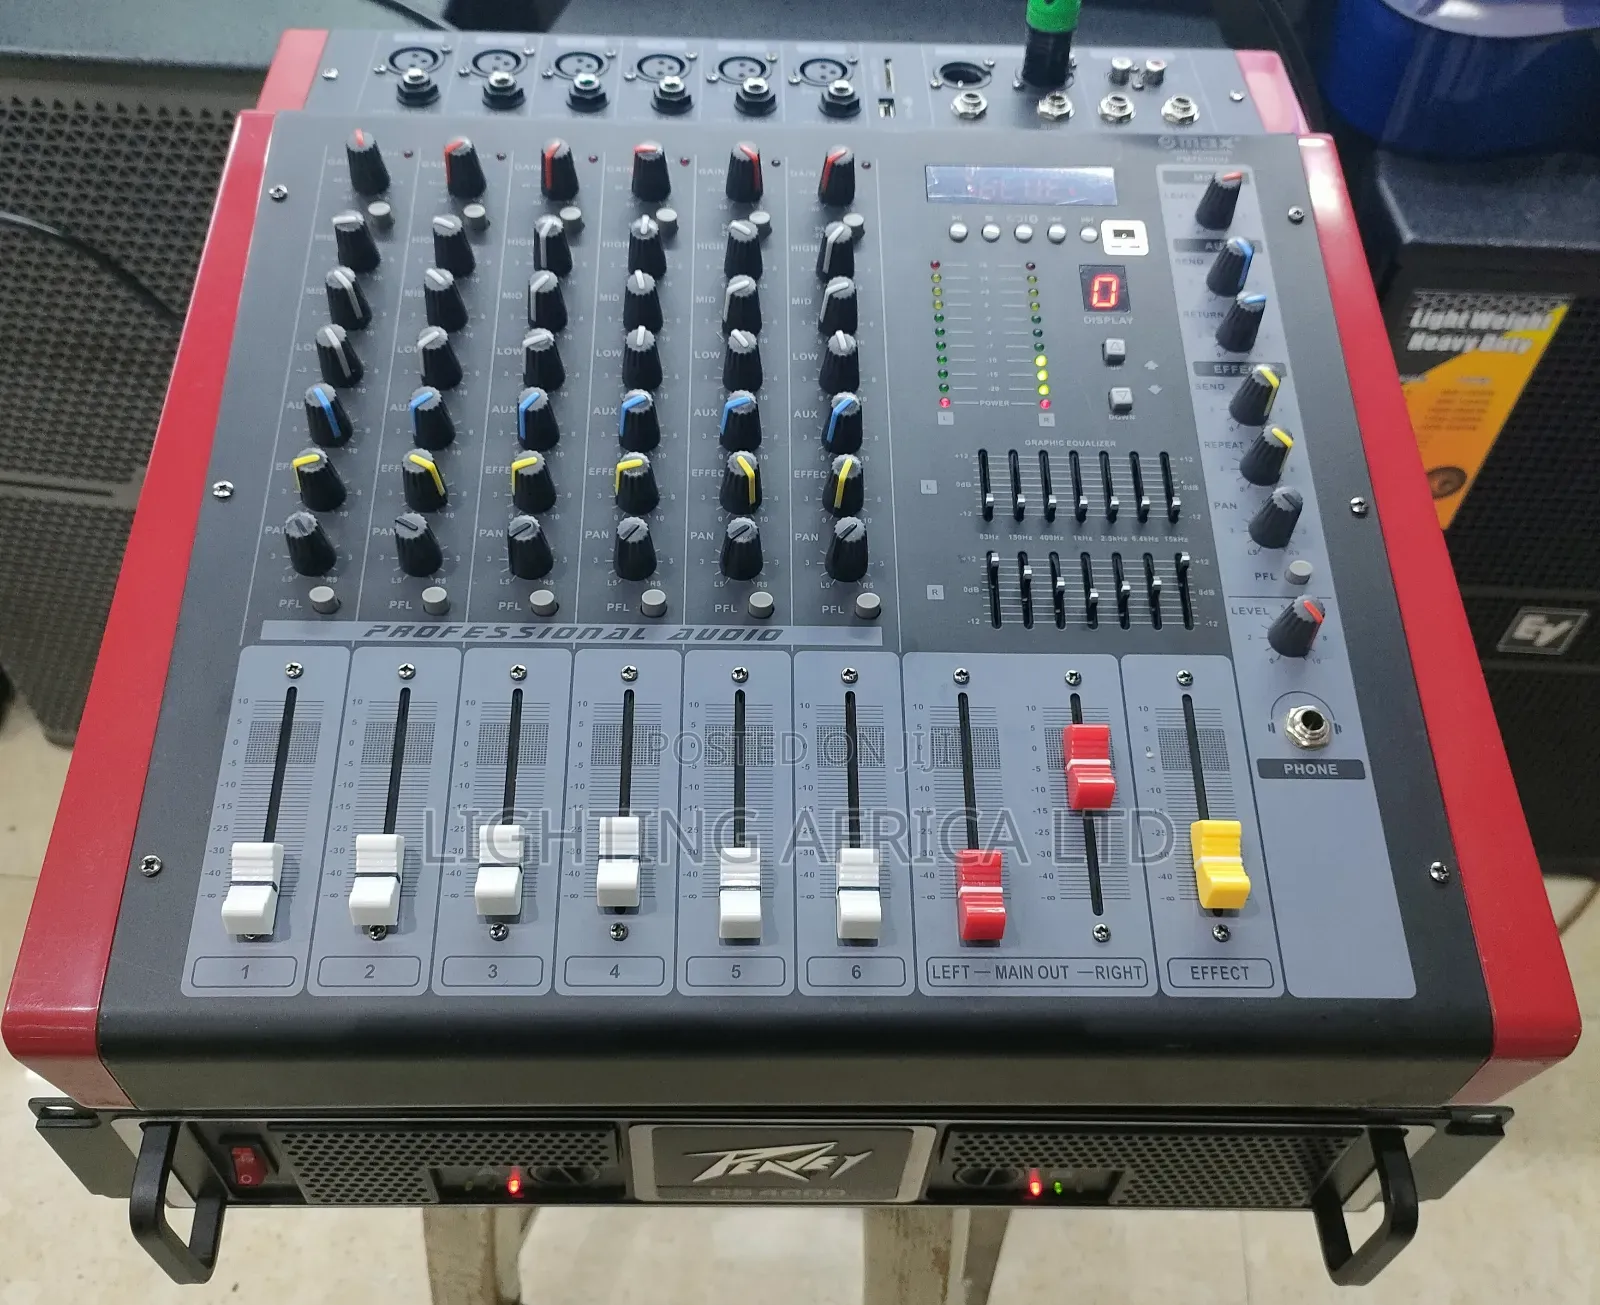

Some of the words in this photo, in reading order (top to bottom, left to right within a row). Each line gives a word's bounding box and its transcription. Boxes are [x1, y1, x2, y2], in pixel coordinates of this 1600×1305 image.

[699, 168, 725, 176] GAIN
[1092, 274, 1120, 308] 0
[502, 292, 522, 300] MID
[600, 293, 620, 301] MID
[696, 296, 716, 304] MID
[792, 296, 812, 305] MID
[1183, 310, 1224, 318] RETURN
[1084, 316, 1133, 325] DISPLAY
[497, 348, 524, 356] LOW
[596, 350, 622, 358] LOW
[694, 351, 720, 359] LOW
[792, 352, 818, 360] LOW
[286, 401, 304, 410] AU
[492, 405, 517, 414] AUX
[592, 407, 618, 416] AUX
[694, 408, 718, 417] AUX
[794, 410, 818, 418] AUX
[1204, 441, 1244, 449] REPEAT
[486, 466, 510, 474] EFFE
[588, 468, 614, 476] EFFE
[692, 470, 724, 478] EFFEC
[794, 470, 829, 479] EFFEC
[1214, 502, 1237, 510] PAN
[479, 530, 504, 538] PAN
[585, 530, 609, 539] PAN
[690, 532, 714, 540] PAN
[795, 532, 819, 541] PAN
[1255, 572, 1277, 581] PFL
[279, 600, 302, 608] PFL
[390, 600, 412, 610] PFL
[498, 602, 522, 611] PFL
[606, 603, 630, 612] PFL
[714, 604, 738, 613] PFL
[822, 605, 845, 614] PFL
[1231, 607, 1269, 615] LEVEL
[363, 624, 647, 640] PROFESSIONAL
[667, 628, 784, 642] AUDIO
[1283, 763, 1338, 776] PHONE
[364, 964, 376, 979] 2
[488, 964, 498, 979] 3
[609, 964, 620, 978] 4
[731, 964, 741, 978] 5
[852, 964, 862, 978] 6
[932, 964, 970, 980] LEFT
[995, 964, 1035, 980] MAIN
[1037, 964, 1069, 980] OUT
[1095, 965, 1142, 981] RIGHT
[1190, 966, 1249, 981] EFFECT
